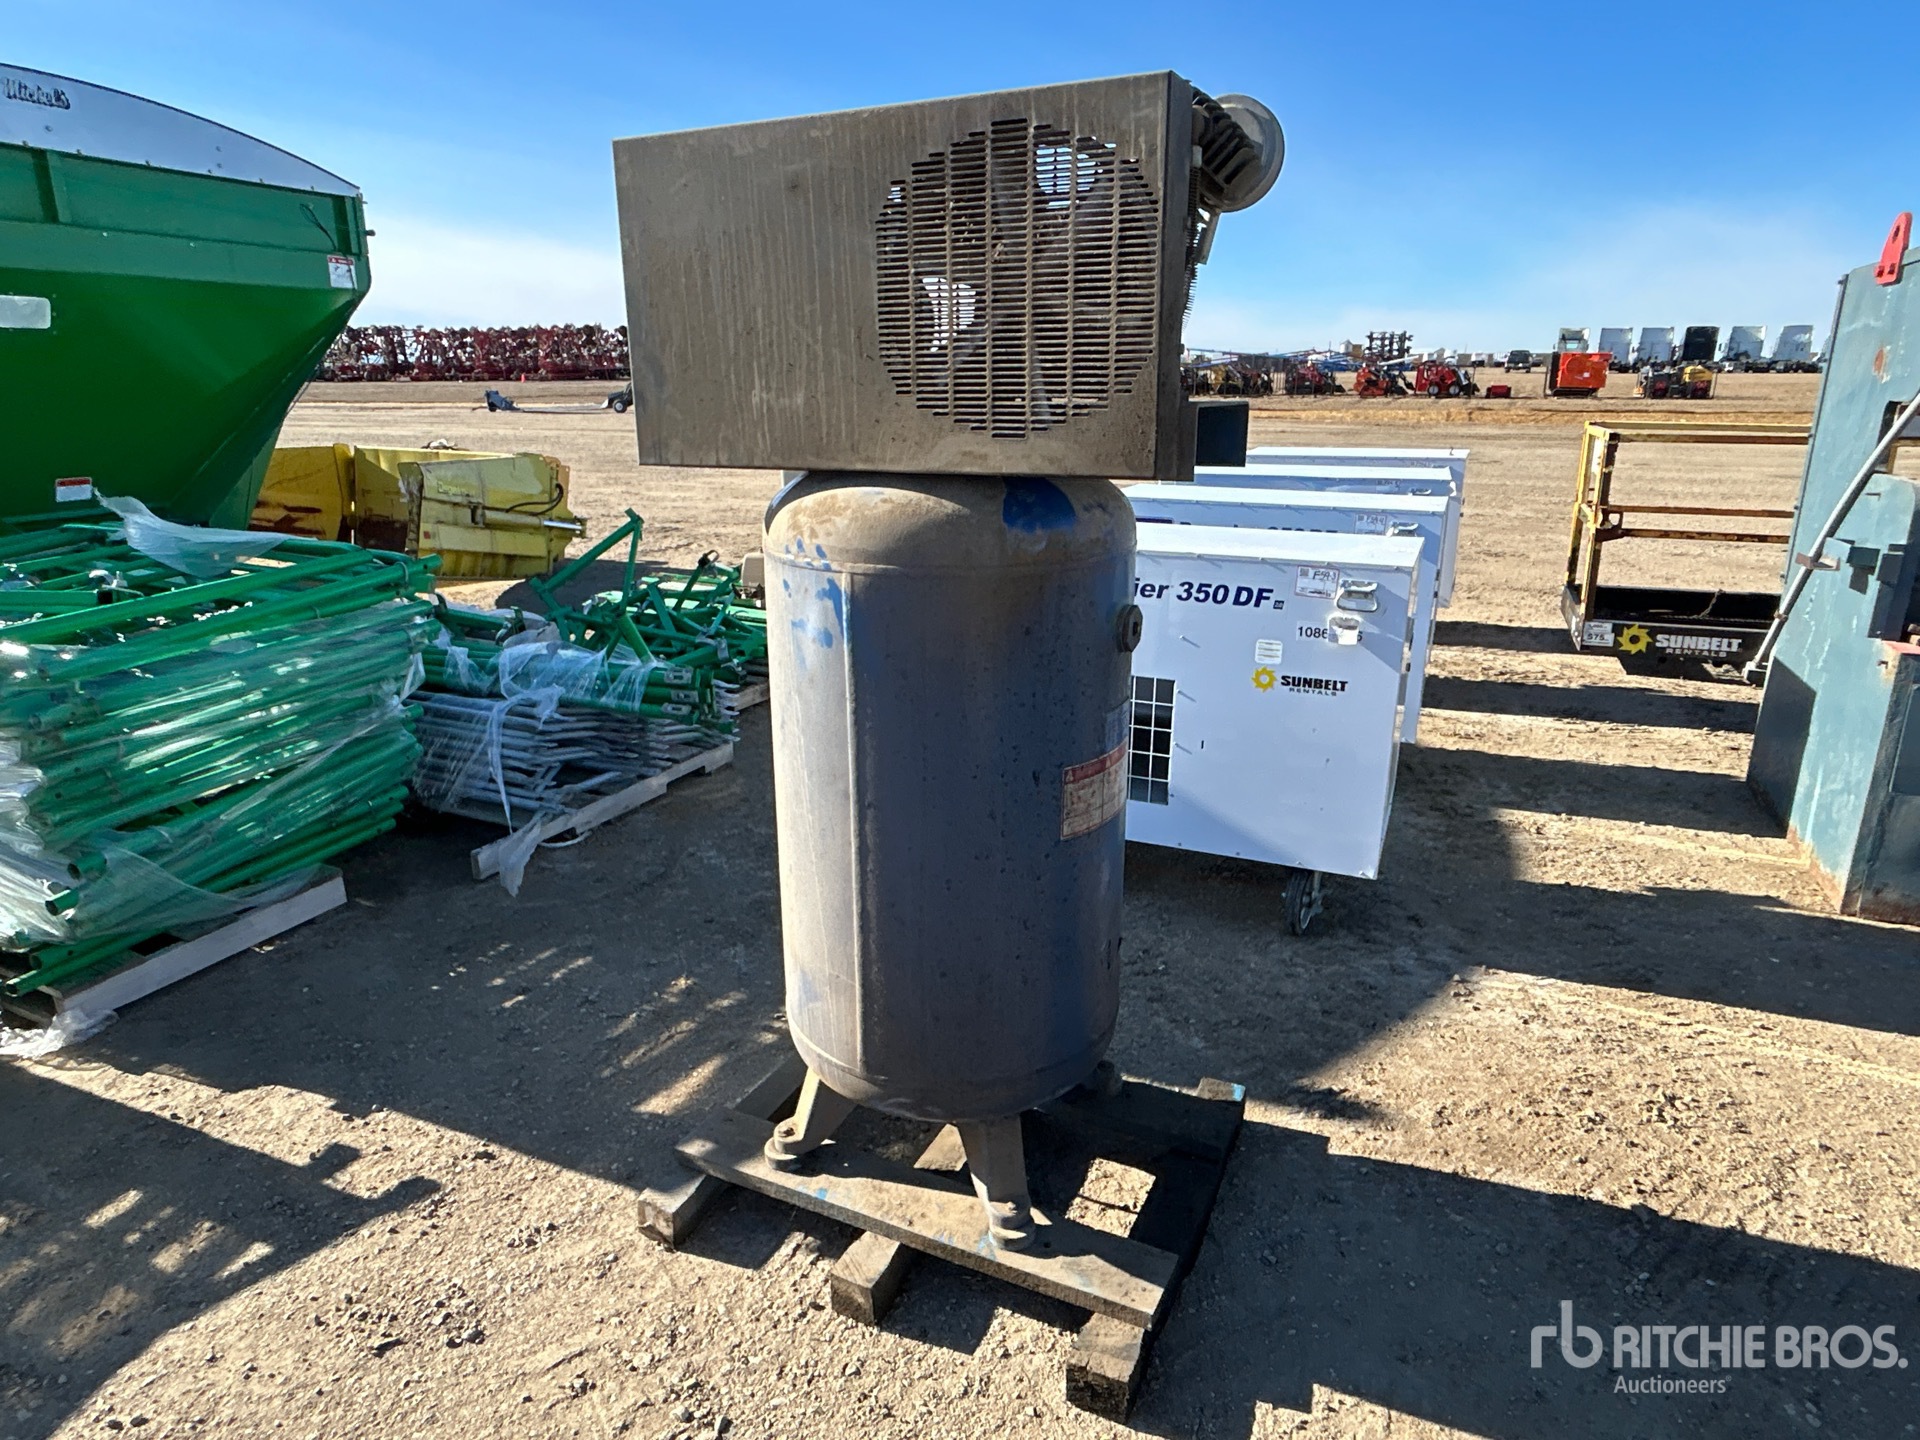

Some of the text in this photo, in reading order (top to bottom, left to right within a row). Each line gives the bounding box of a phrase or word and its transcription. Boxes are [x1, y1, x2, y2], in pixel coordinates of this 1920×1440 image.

[1176, 581, 1230, 605] 350
[1232, 586, 1274, 608] DF
[1655, 634, 1743, 652] SUNBELT
[1666, 648, 1728, 658] RENTALS
[1280, 675, 1349, 692] SUNBELT
[1289, 687, 1338, 697] RENTALS
